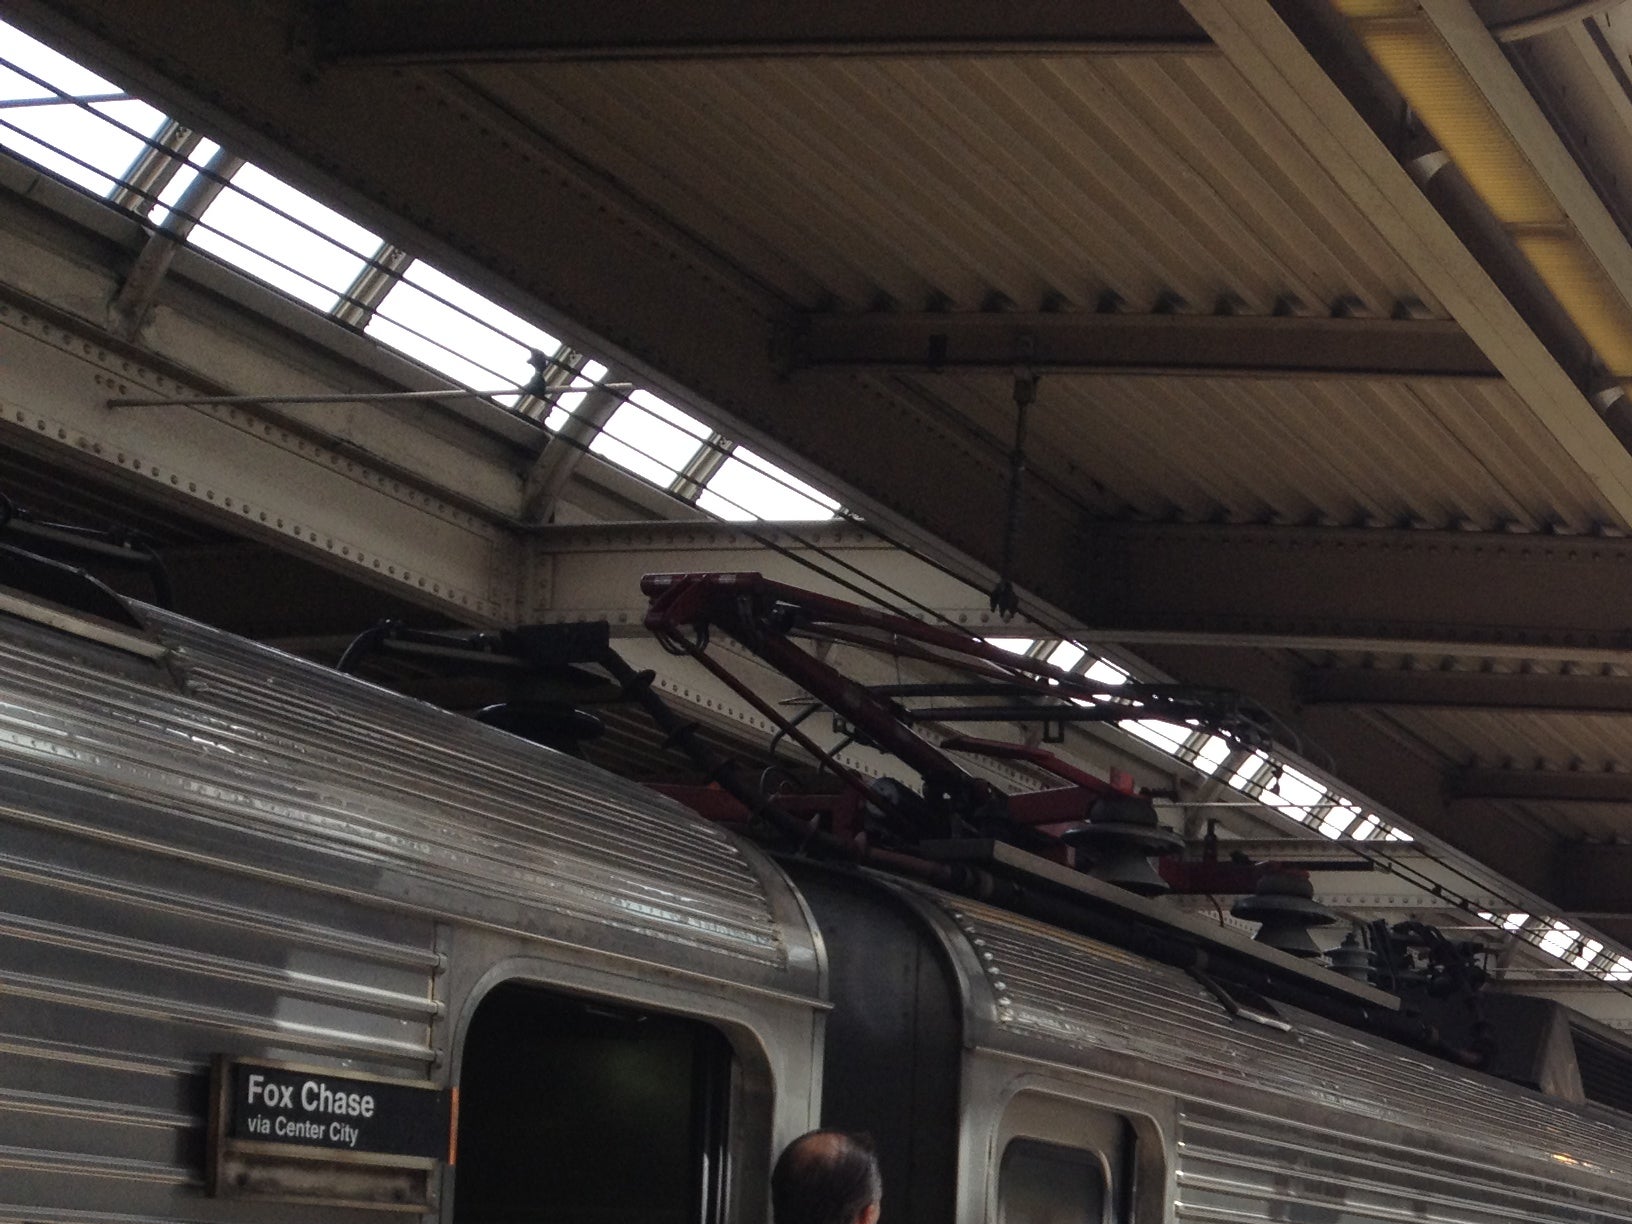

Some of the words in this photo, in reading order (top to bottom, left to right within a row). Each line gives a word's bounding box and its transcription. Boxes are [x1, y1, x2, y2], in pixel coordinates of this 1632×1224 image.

[248, 1074, 294, 1109] Fox
[301, 1081, 375, 1118] Chase
[248, 1114, 271, 1134] via
[275, 1116, 325, 1140] Center
[329, 1122, 359, 1147] City
